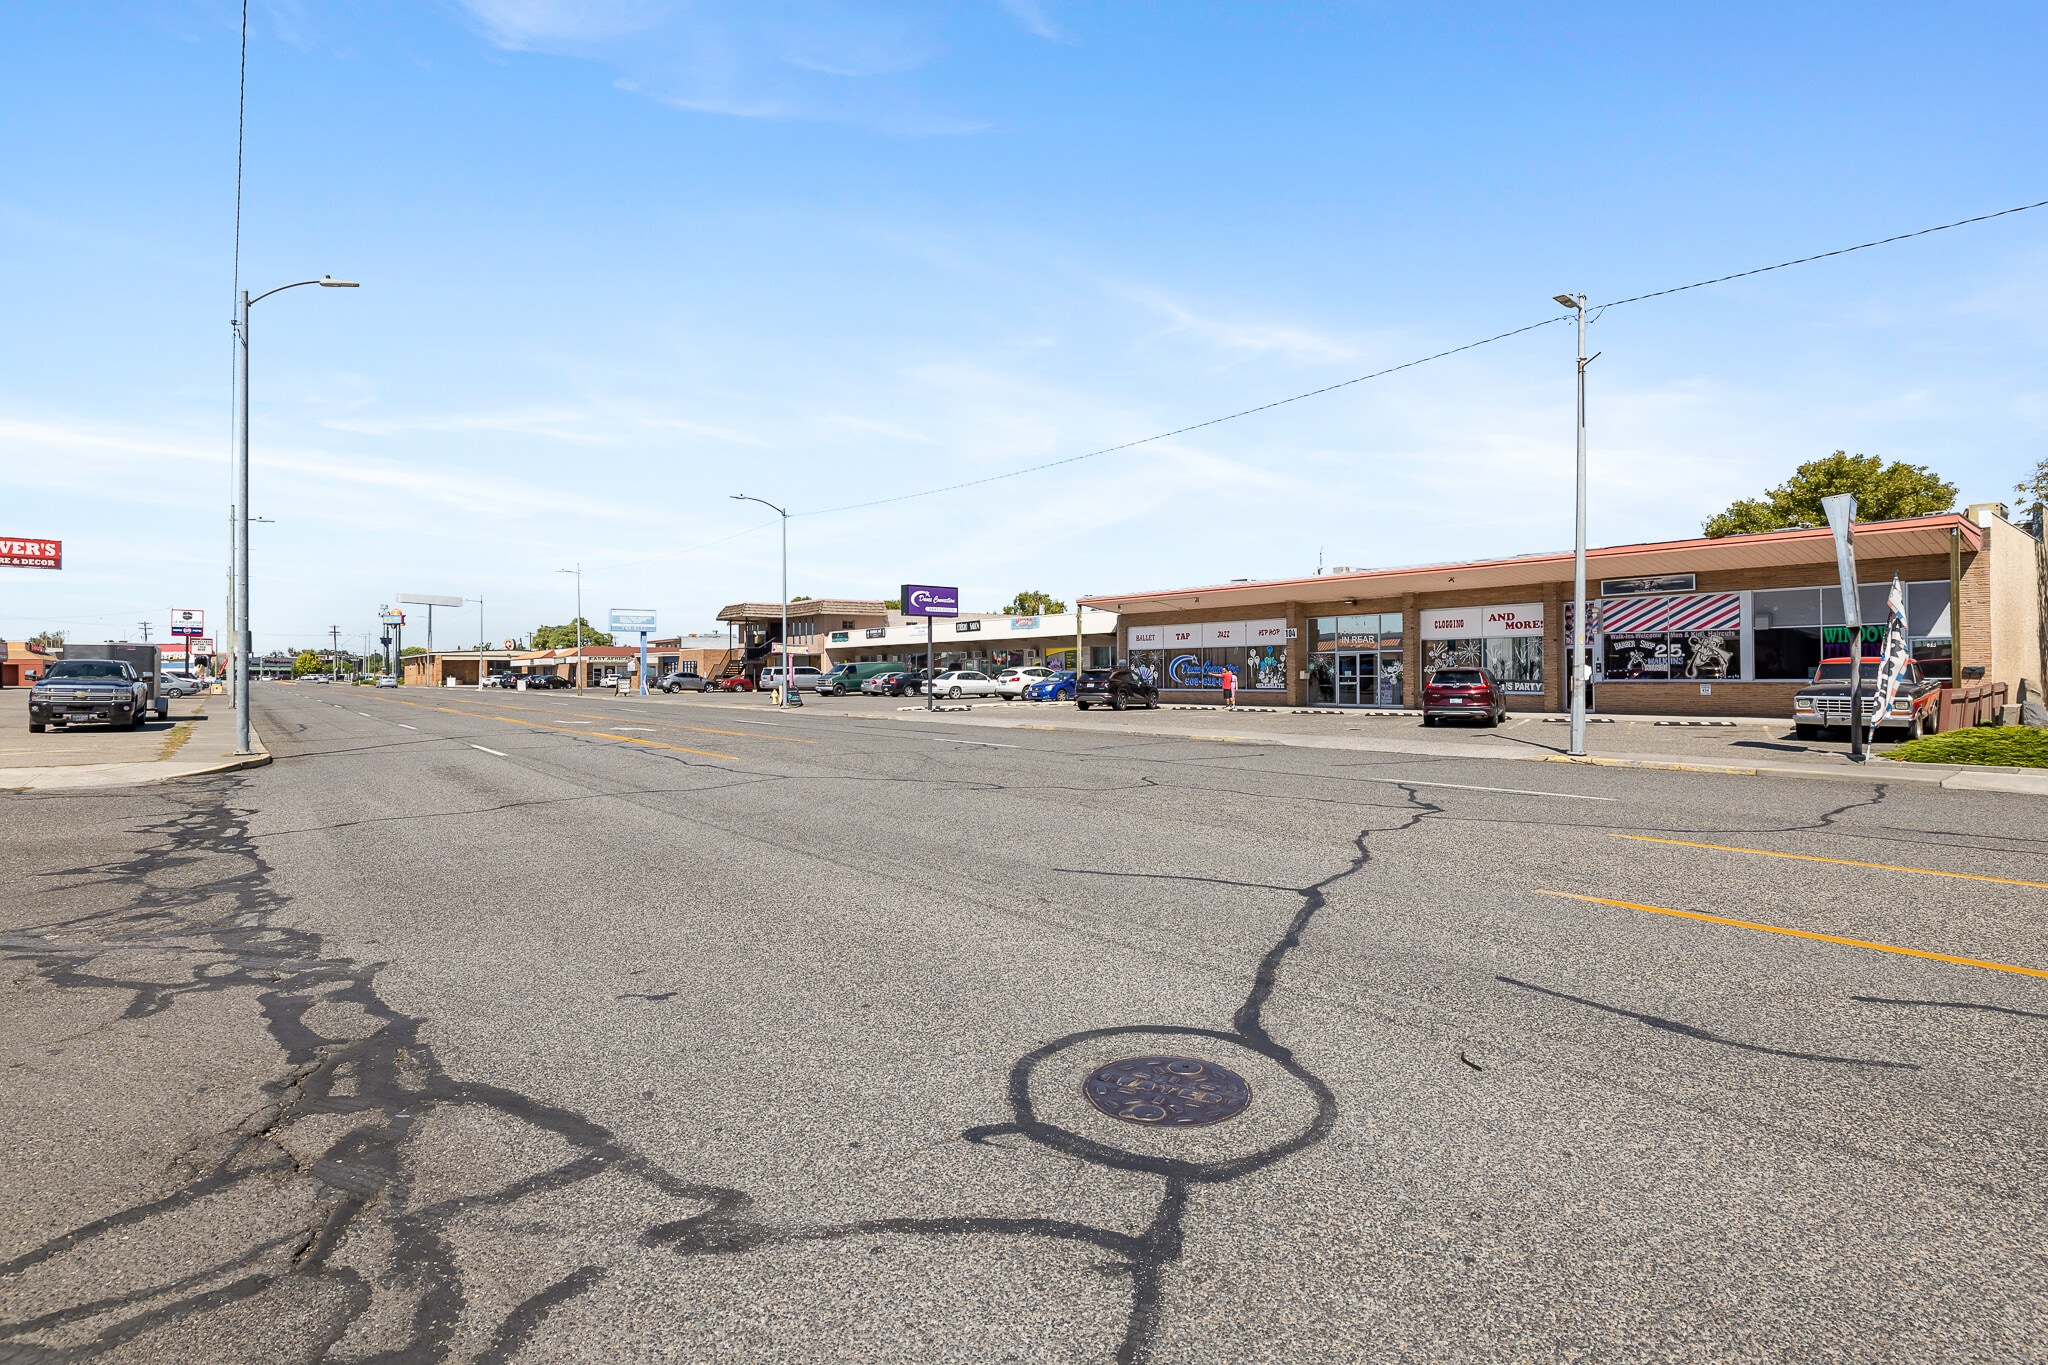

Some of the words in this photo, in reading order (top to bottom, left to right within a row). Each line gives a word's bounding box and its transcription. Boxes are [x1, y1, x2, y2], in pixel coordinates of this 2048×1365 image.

[0, 541, 56, 557] VER'S
[21, 558, 56, 566] DECOR
[918, 594, 933, 603] Dance
[1488, 612, 1516, 622] AND
[1434, 619, 1465, 629] CLOGGING
[1505, 620, 1544, 630] MORE!
[1175, 632, 1191, 641] TAP
[1217, 630, 1230, 639] JAZZ
[1269, 628, 1280, 636] HOP
[1285, 629, 1296, 638] 104
[1135, 634, 1155, 642] BALLET
[1341, 636, 1350, 644] IN
[1351, 635, 1375, 644] REAR
[1639, 639, 1656, 650] SHOP
[1823, 642, 1881, 658] TININ
[1647, 657, 1668, 665] WALK
[1670, 657, 1684, 665] INS
[1202, 659, 1240, 675] Connetion
[1514, 682, 1543, 691] PARTY
